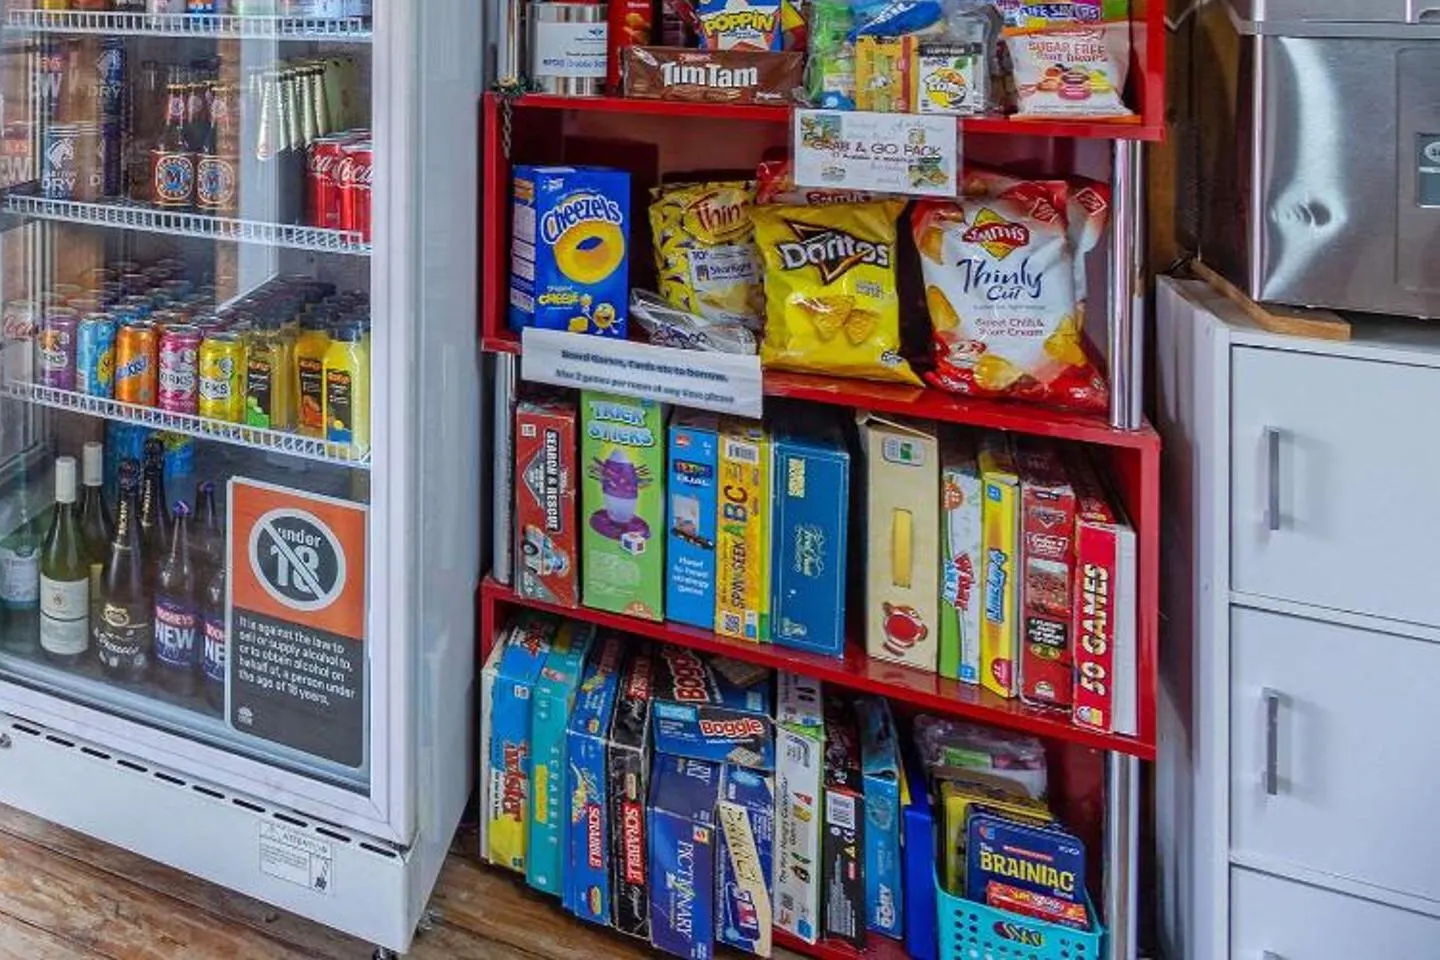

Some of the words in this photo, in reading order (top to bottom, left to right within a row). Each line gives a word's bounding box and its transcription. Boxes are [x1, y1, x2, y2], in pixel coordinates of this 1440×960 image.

[703, 9, 774, 33] POPPIN
[1027, 41, 1072, 55] SUGAR
[1074, 43, 1106, 55] FREE
[871, 143, 899, 155] GO
[903, 144, 942, 157] PACK
[41, 177, 76, 191] DRY
[542, 194, 623, 244] Cheezels
[778, 233, 890, 270] Doritos
[957, 257, 1045, 298] Thinly
[986, 284, 1025, 301] Cut
[1007, 327, 1044, 338] Cream
[581, 373, 611, 386] games
[611, 377, 628, 389] per
[546, 430, 559, 474] SEARCH
[547, 475, 558, 487] &
[546, 487, 559, 531] RESCUE
[277, 526, 323, 549] under
[270, 543, 321, 594] 18
[1081, 562, 1109, 657] GAMES
[155, 620, 196, 650] NEW
[205, 636, 225, 659] NE
[239, 631, 256, 644] sell
[257, 636, 267, 646] or
[268, 640, 300, 658] supply
[302, 648, 340, 667] alcohol
[295, 632, 312, 646] the
[312, 637, 331, 651] law
[332, 642, 345, 654] to
[239, 644, 249, 654] or
[251, 646, 260, 658] to
[294, 659, 330, 678] alcohol
[331, 671, 345, 683] on
[239, 668, 255, 683] the
[256, 675, 274, 689] age
[275, 680, 286, 692] of
[1079, 660, 1108, 696] 50
[291, 673, 326, 691] person
[326, 682, 357, 700] under
[699, 718, 765, 738] Boggle
[548, 745, 561, 846] SCRABBLE
[588, 805, 602, 868] SCRABBLE
[624, 806, 642, 883] SCRABBLE
[979, 849, 1076, 892] BRAINIAC
[675, 839, 697, 939] PICTIONARY
